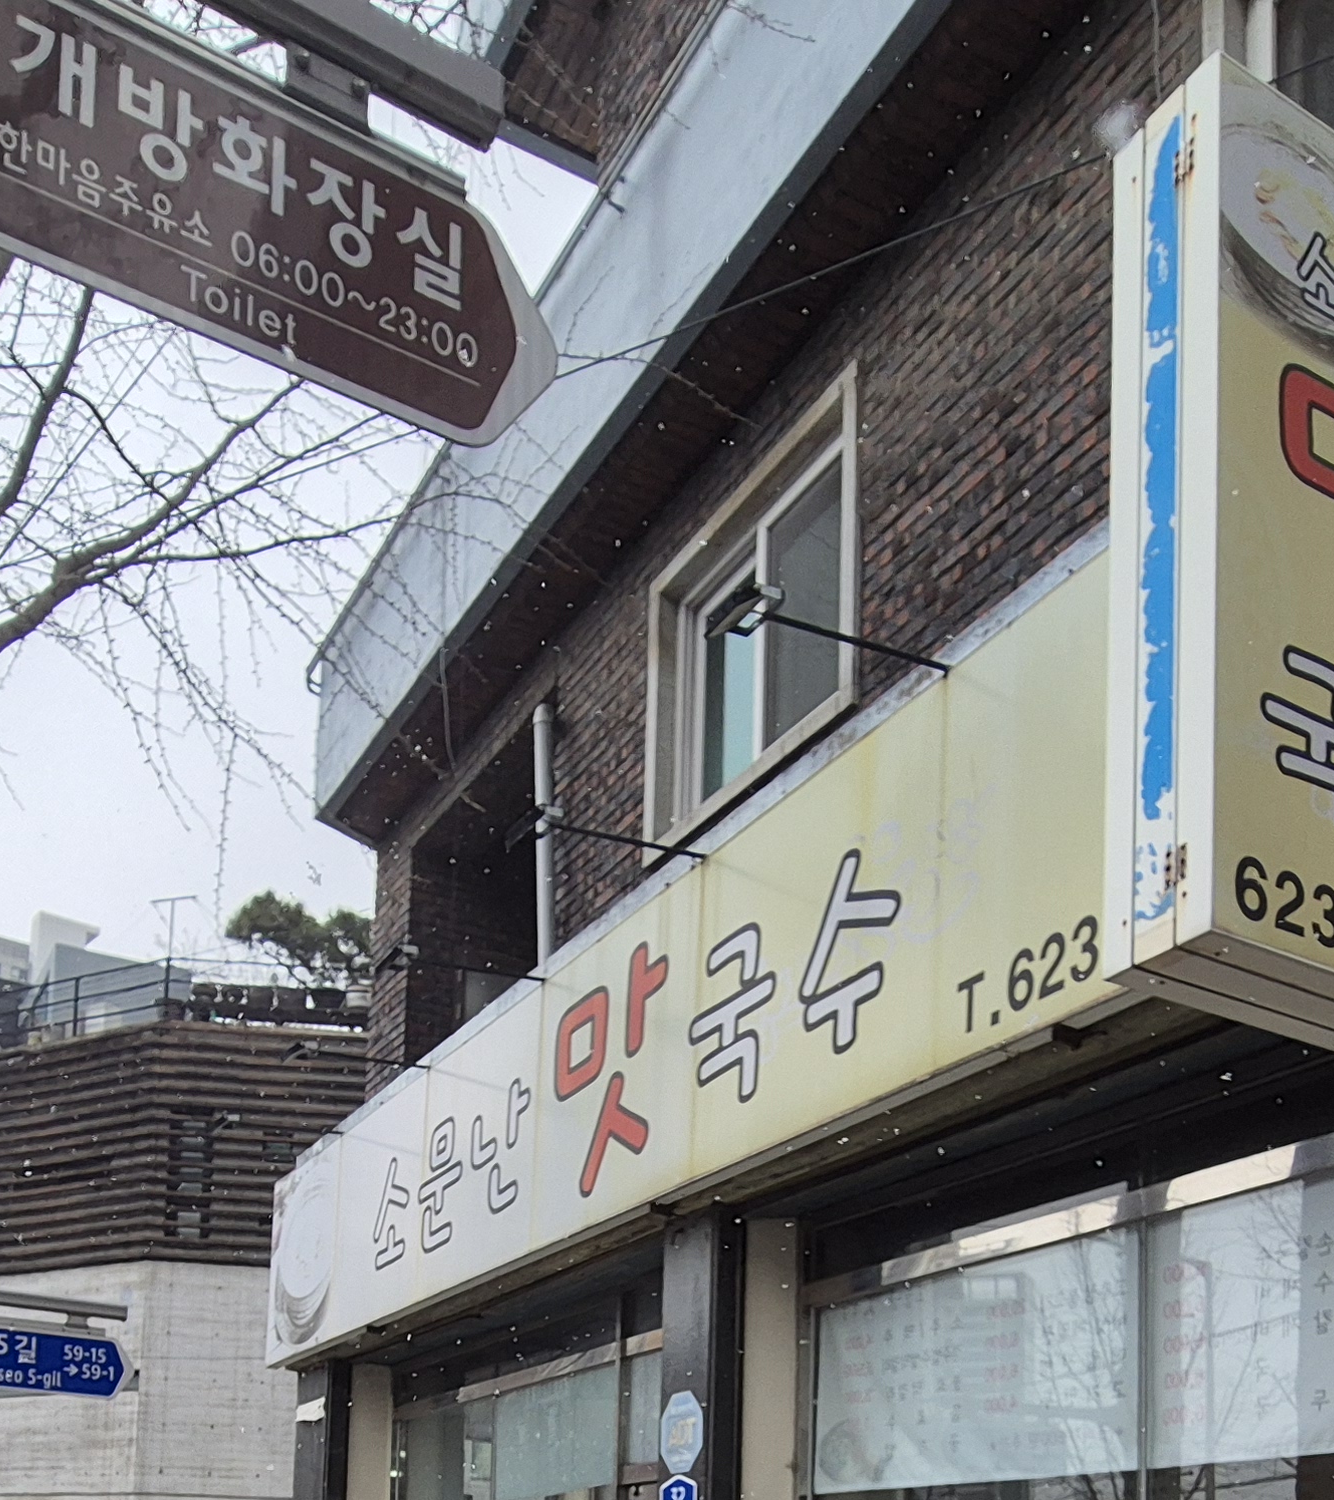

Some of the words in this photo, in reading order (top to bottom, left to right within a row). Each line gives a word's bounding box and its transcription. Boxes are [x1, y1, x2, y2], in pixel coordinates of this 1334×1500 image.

[9, 14, 464, 310] 개방화장실
[180, 264, 298, 346] Toilet
[230, 232, 480, 369] 06:00~23:00
[374, 1078, 531, 1271] 소문난
[27, 1368, 62, 1390] 5-gil
[81, 1363, 115, 1382] 59-1
[63, 1344, 108, 1365] 59-15
